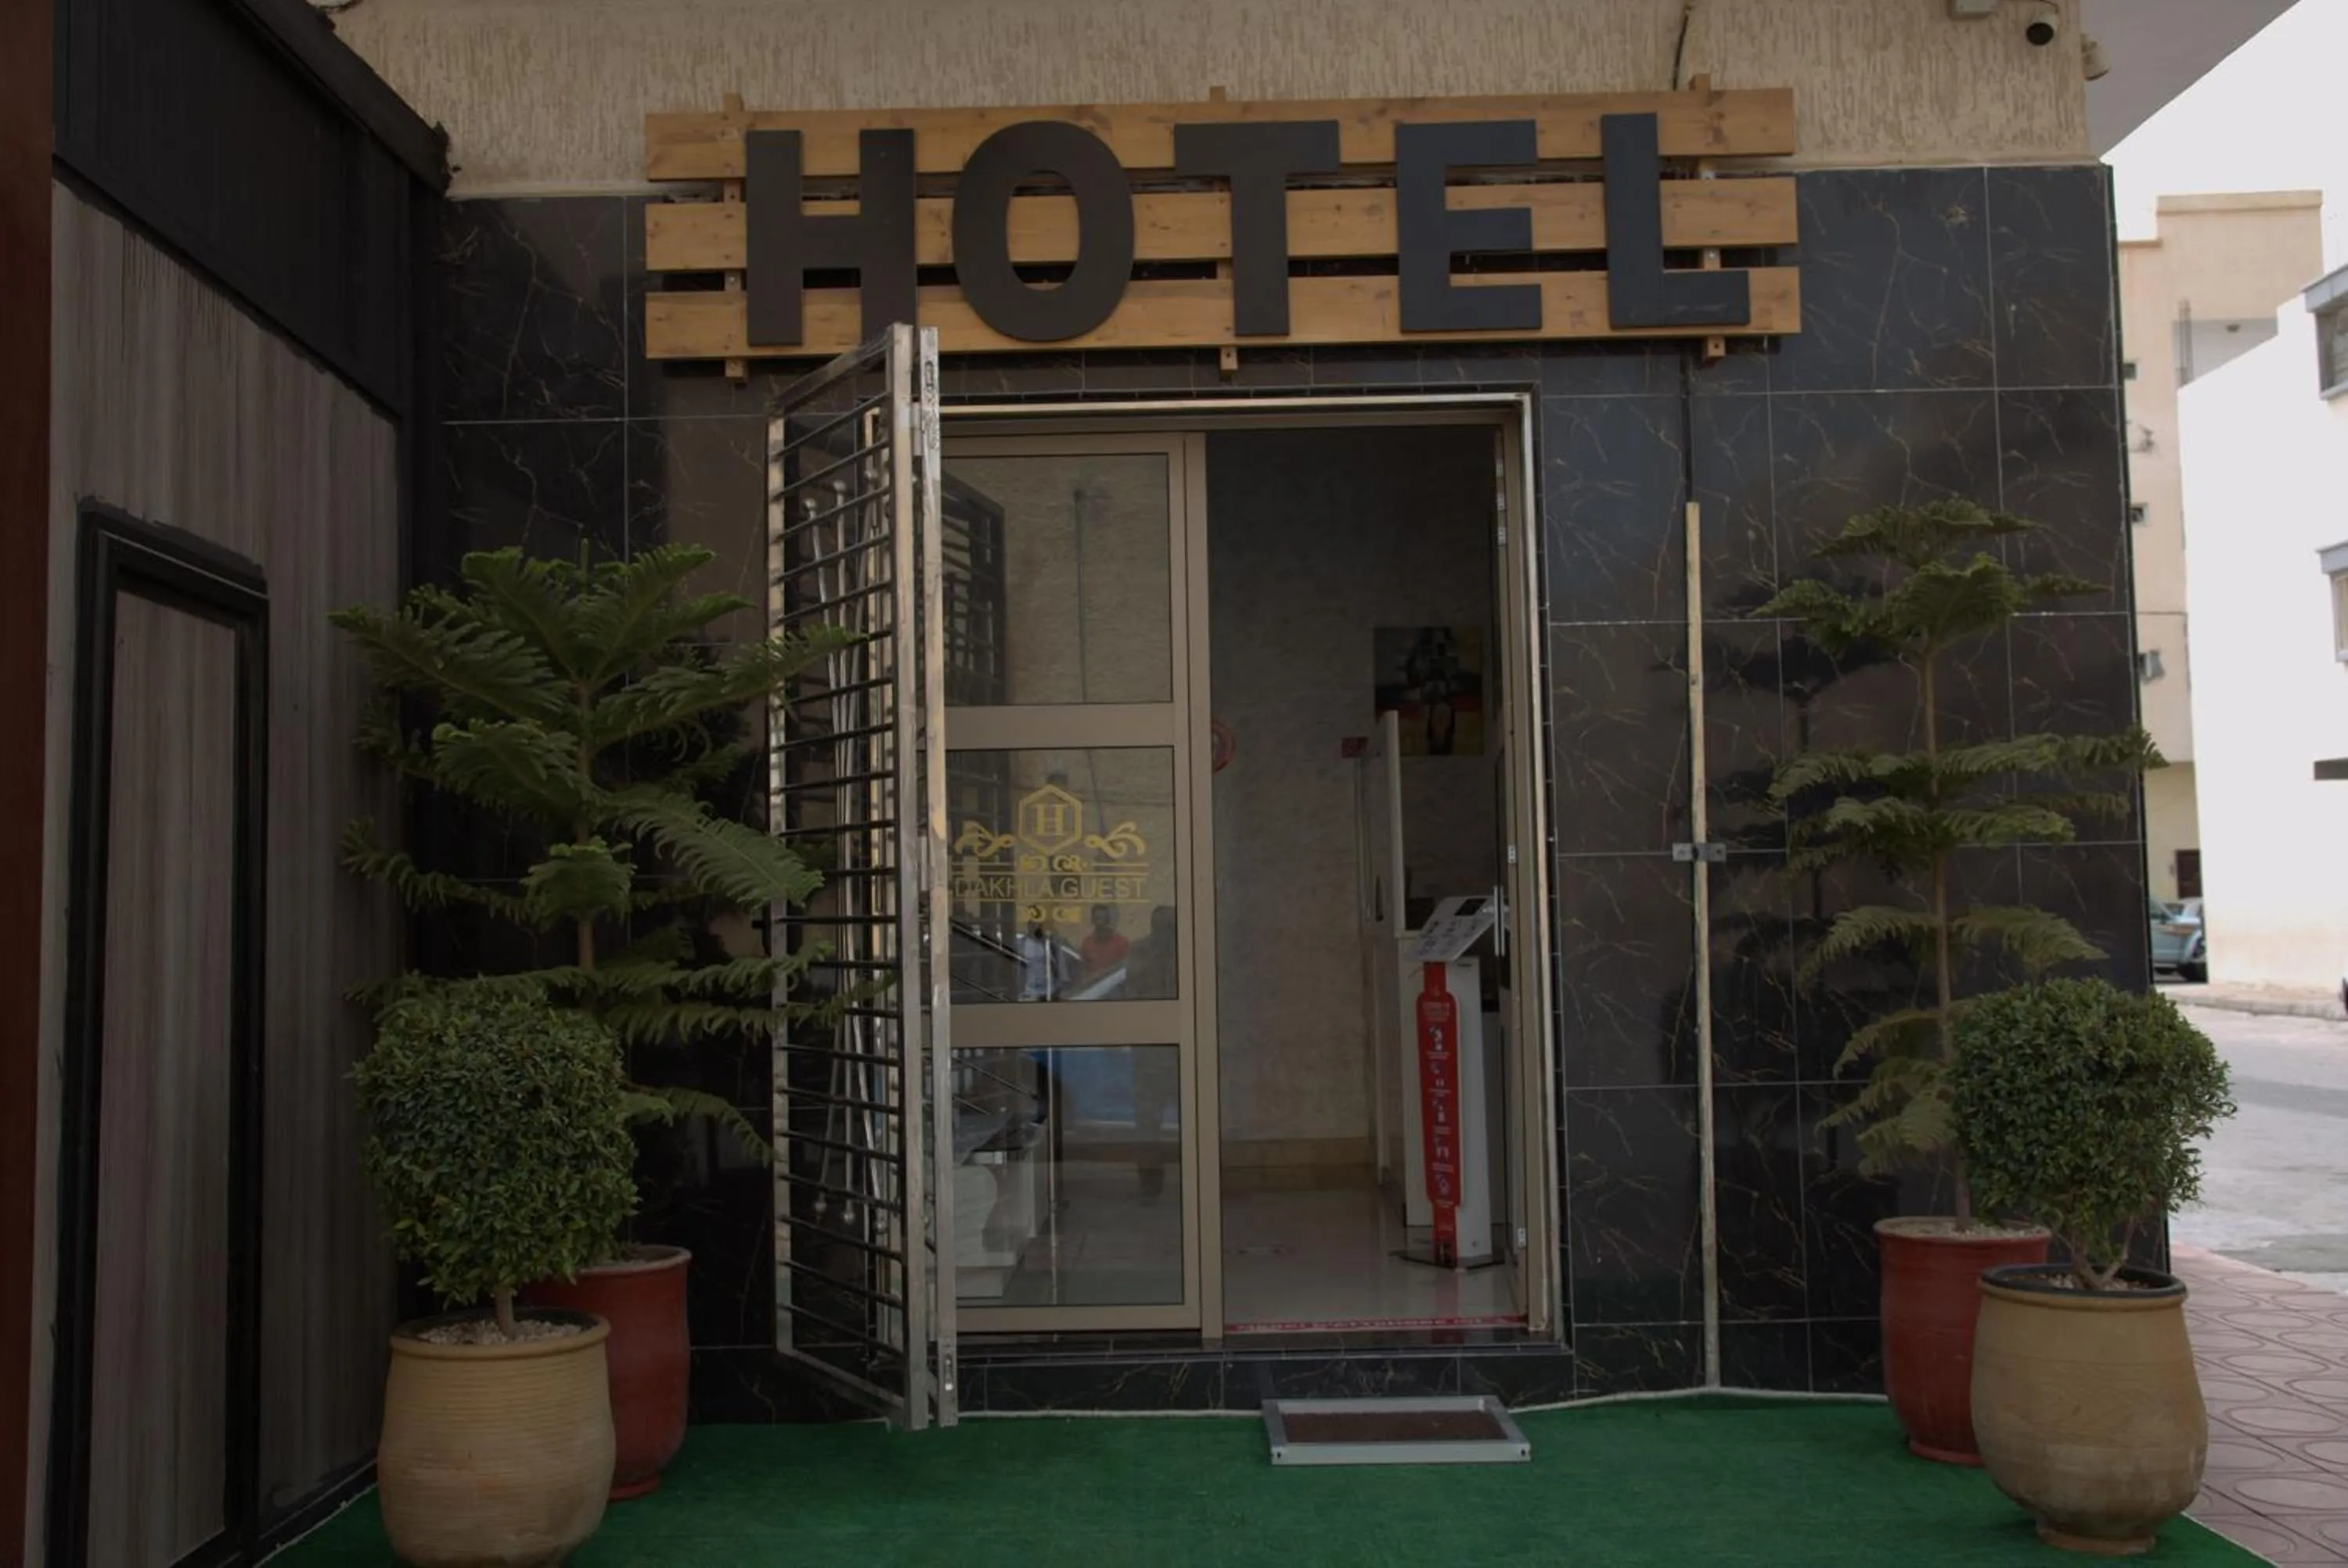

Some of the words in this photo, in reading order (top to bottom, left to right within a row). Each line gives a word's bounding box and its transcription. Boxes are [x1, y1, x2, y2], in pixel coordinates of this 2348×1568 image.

[746, 113, 1751, 346] HOTEL
[954, 877, 1053, 898] DAKHLA
[1060, 877, 1147, 898] GUEST
